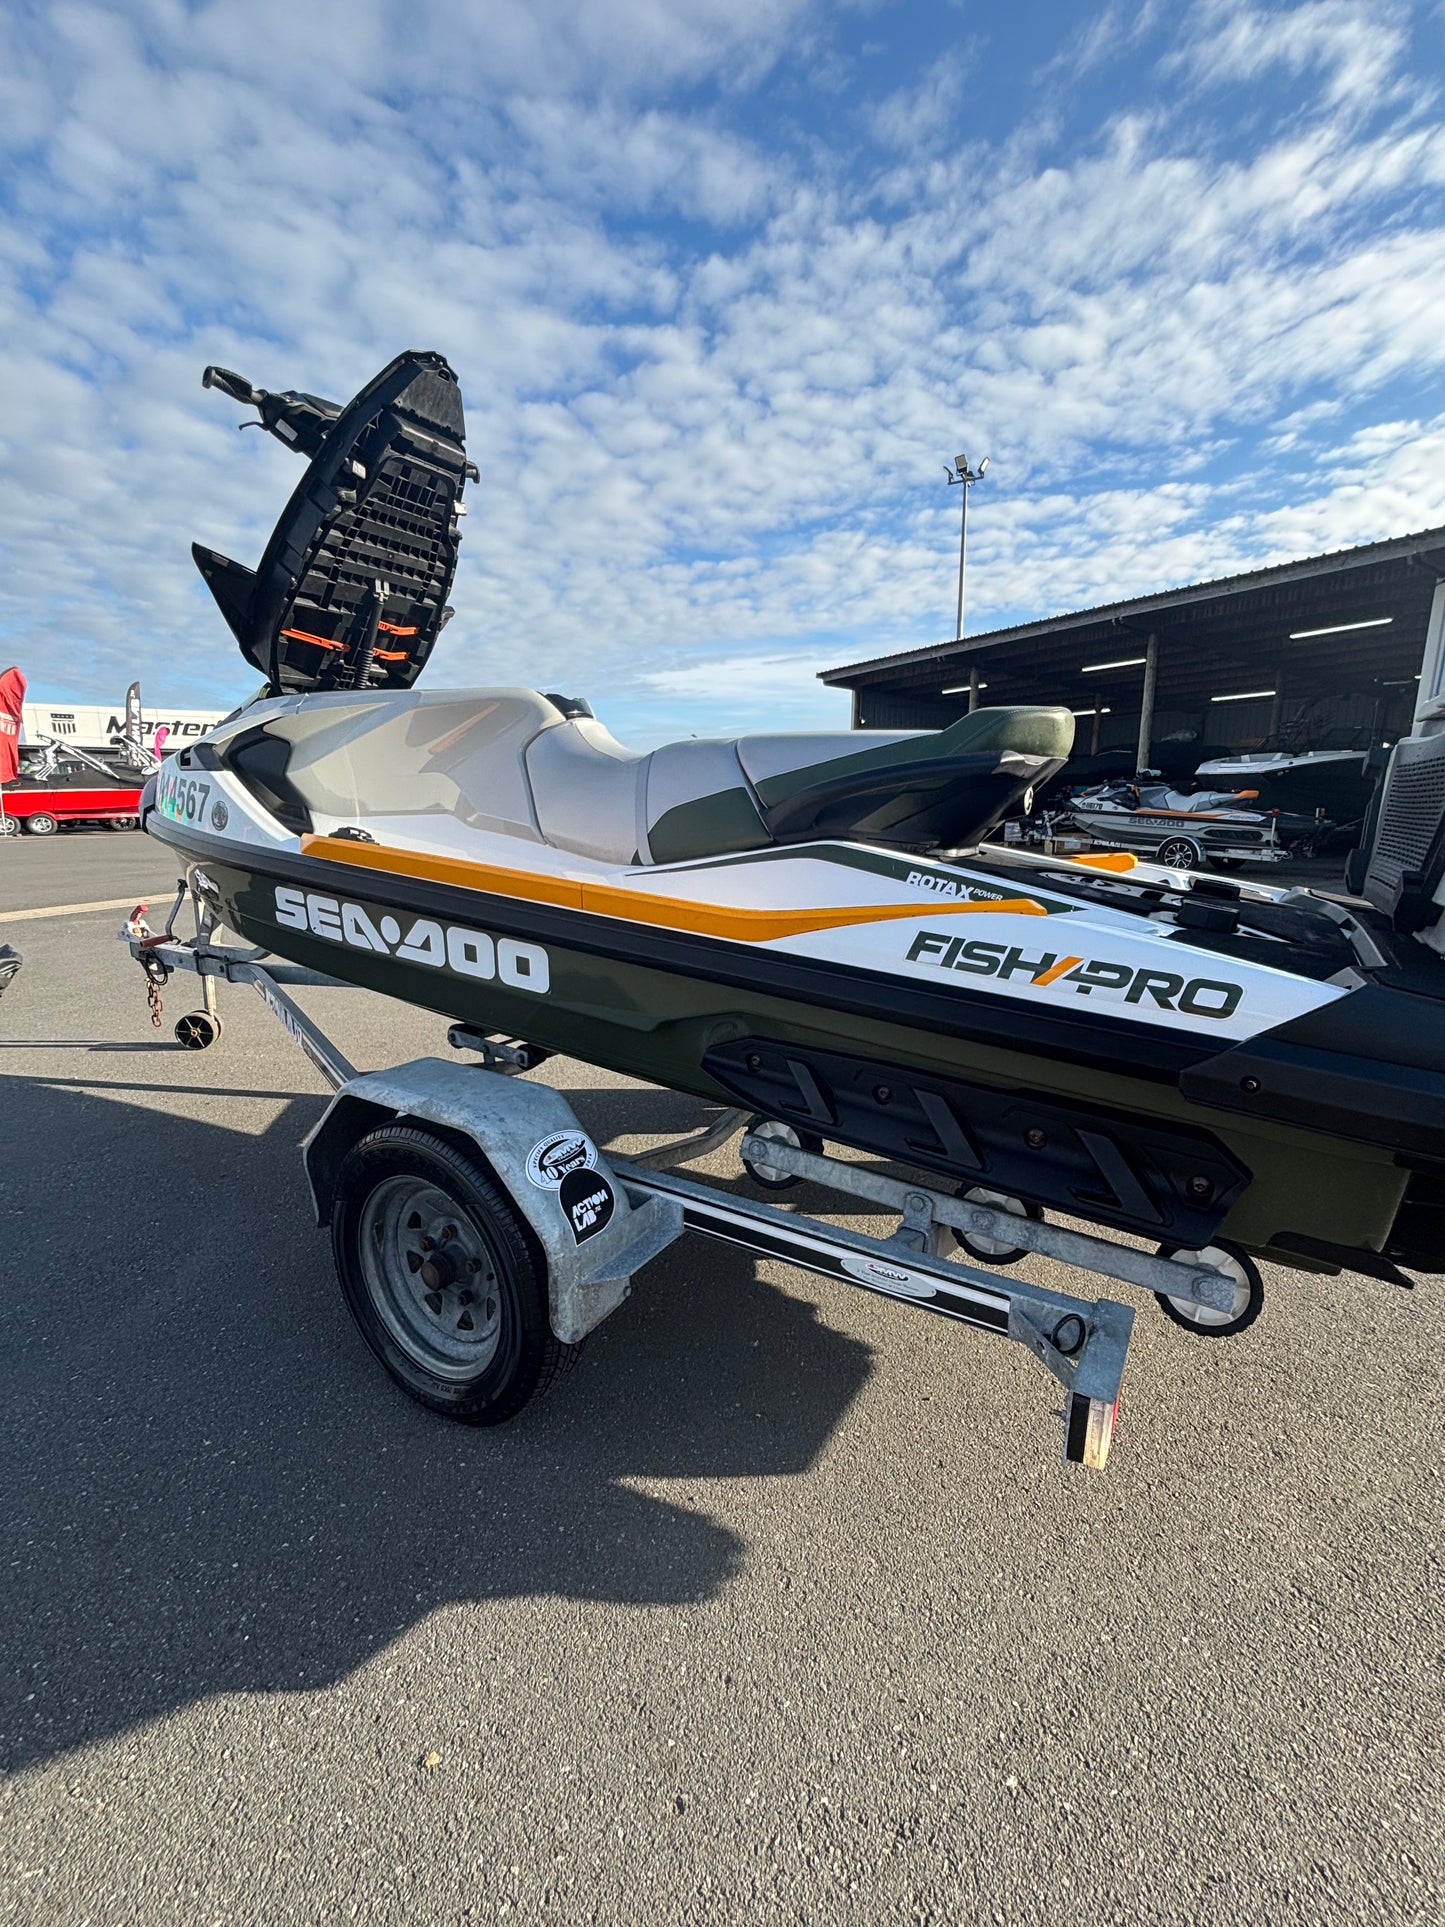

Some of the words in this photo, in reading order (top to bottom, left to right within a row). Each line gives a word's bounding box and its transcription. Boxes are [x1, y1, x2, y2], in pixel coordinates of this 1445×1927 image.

[906, 871, 975, 901] ROTAX
[973, 888, 1003, 901] POWER
[543, 1134, 565, 1147] QUALITY
[540, 1166, 559, 1184] 40
[557, 1155, 586, 1174] Years
[572, 1189, 608, 1219] ACTION
[574, 1209, 597, 1232] LAB
